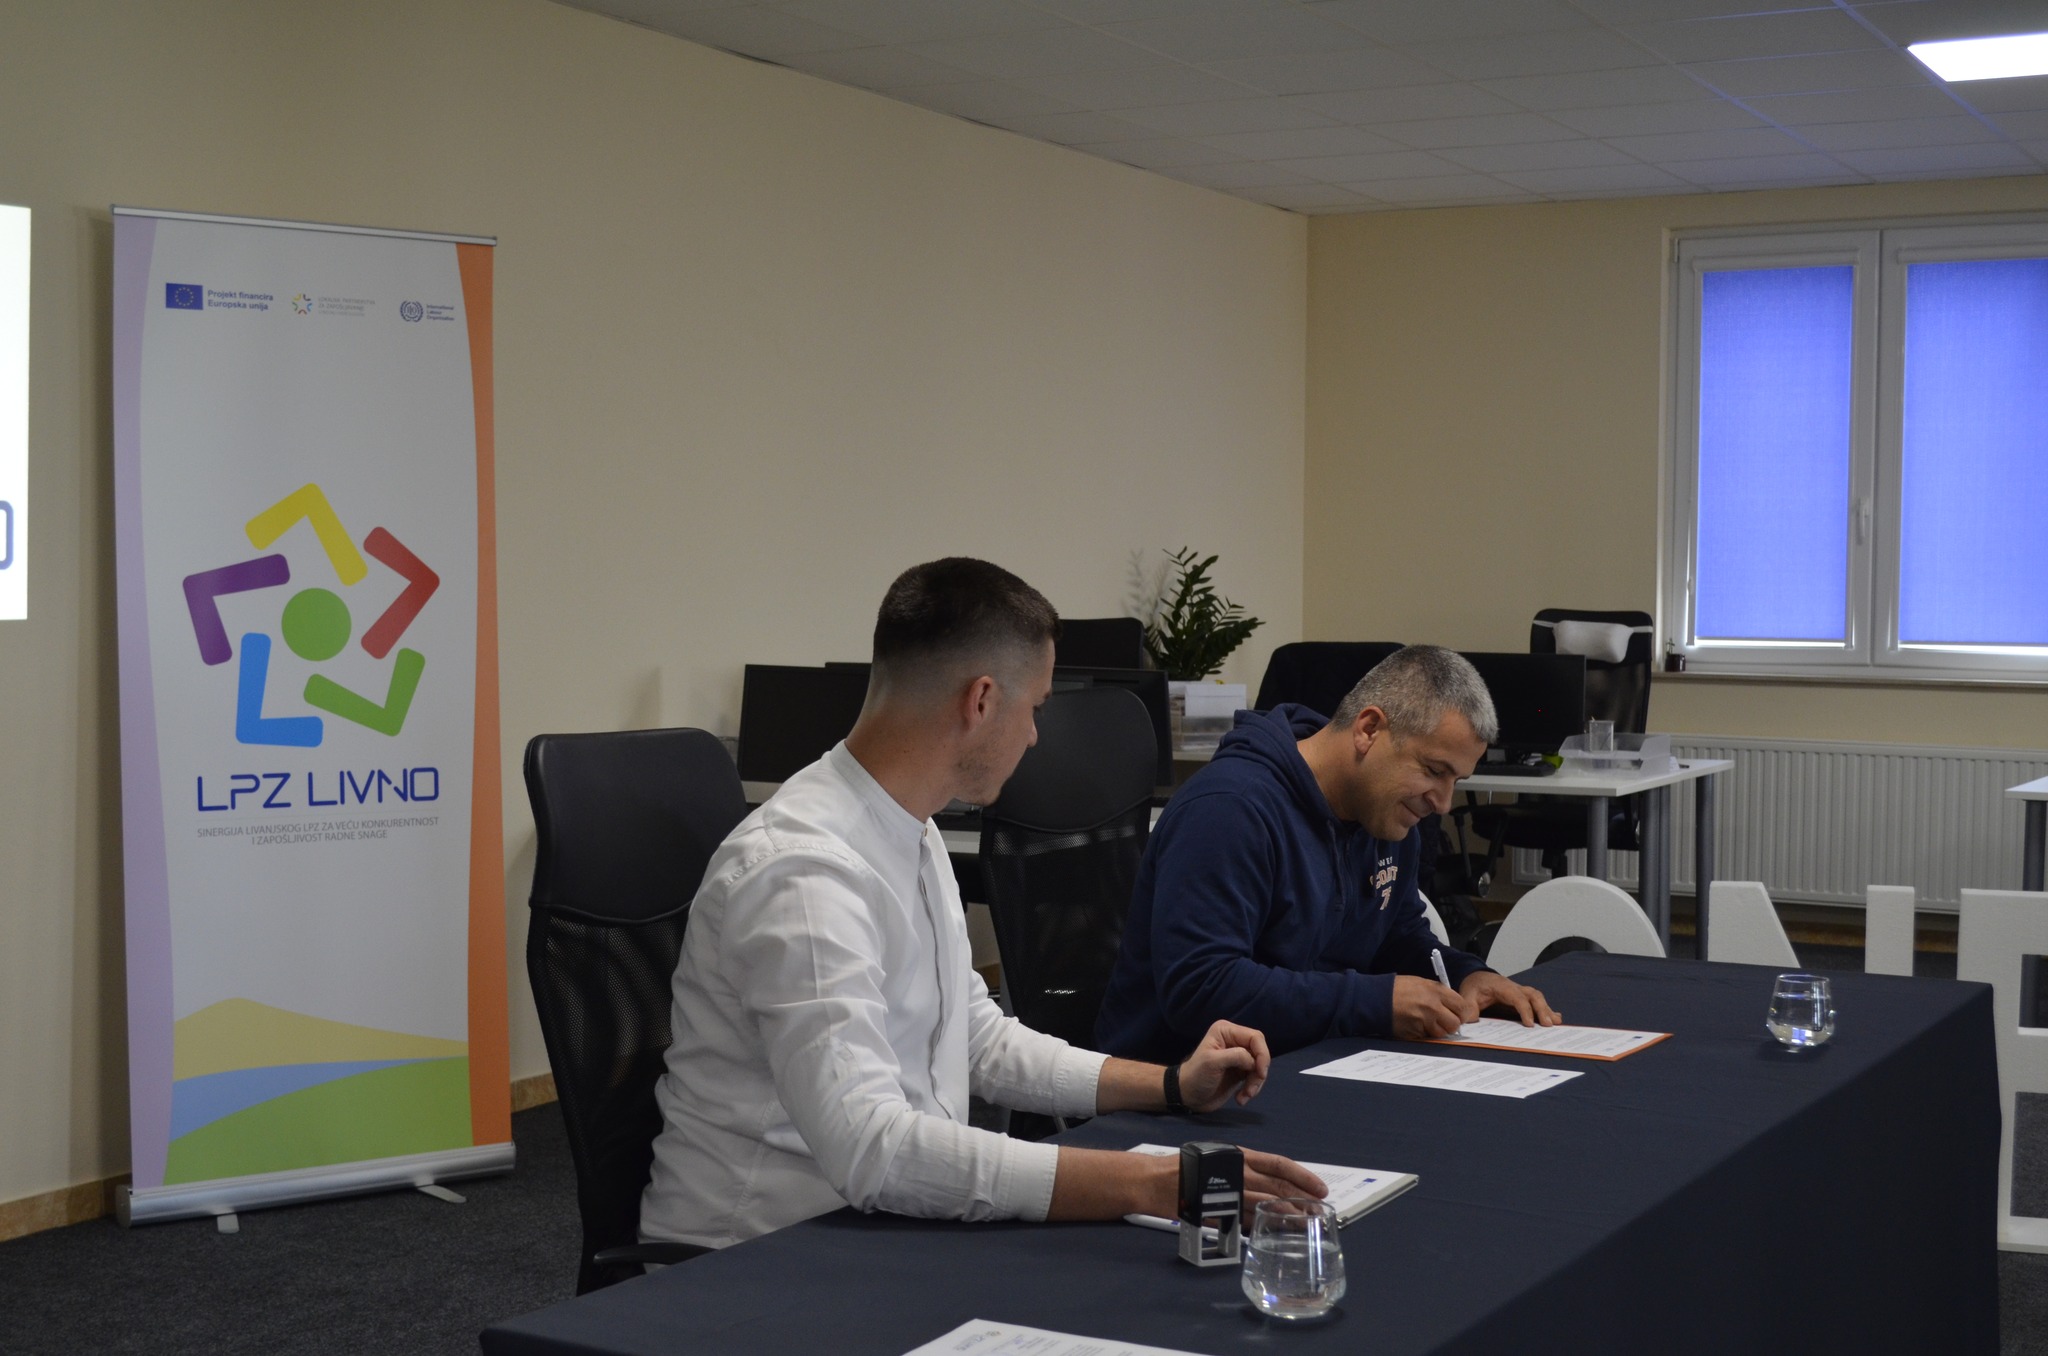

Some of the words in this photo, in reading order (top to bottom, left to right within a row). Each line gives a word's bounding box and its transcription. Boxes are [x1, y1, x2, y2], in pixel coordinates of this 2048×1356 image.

[207, 290, 237, 299] Projekt
[239, 291, 274, 301] financira
[207, 299, 247, 308] Europska
[249, 302, 268, 311] unija
[197, 772, 292, 812] LPZ
[308, 767, 439, 806] LIVNO
[197, 826, 244, 838] SINERGIJA
[246, 823, 301, 836] LIVANJSKOG
[303, 822, 320, 832] LPZ
[321, 821, 334, 831] ZA
[361, 816, 438, 829] KONKURENTNOST
[325, 830, 356, 841] RADNE
[358, 829, 388, 840] SNAGE
